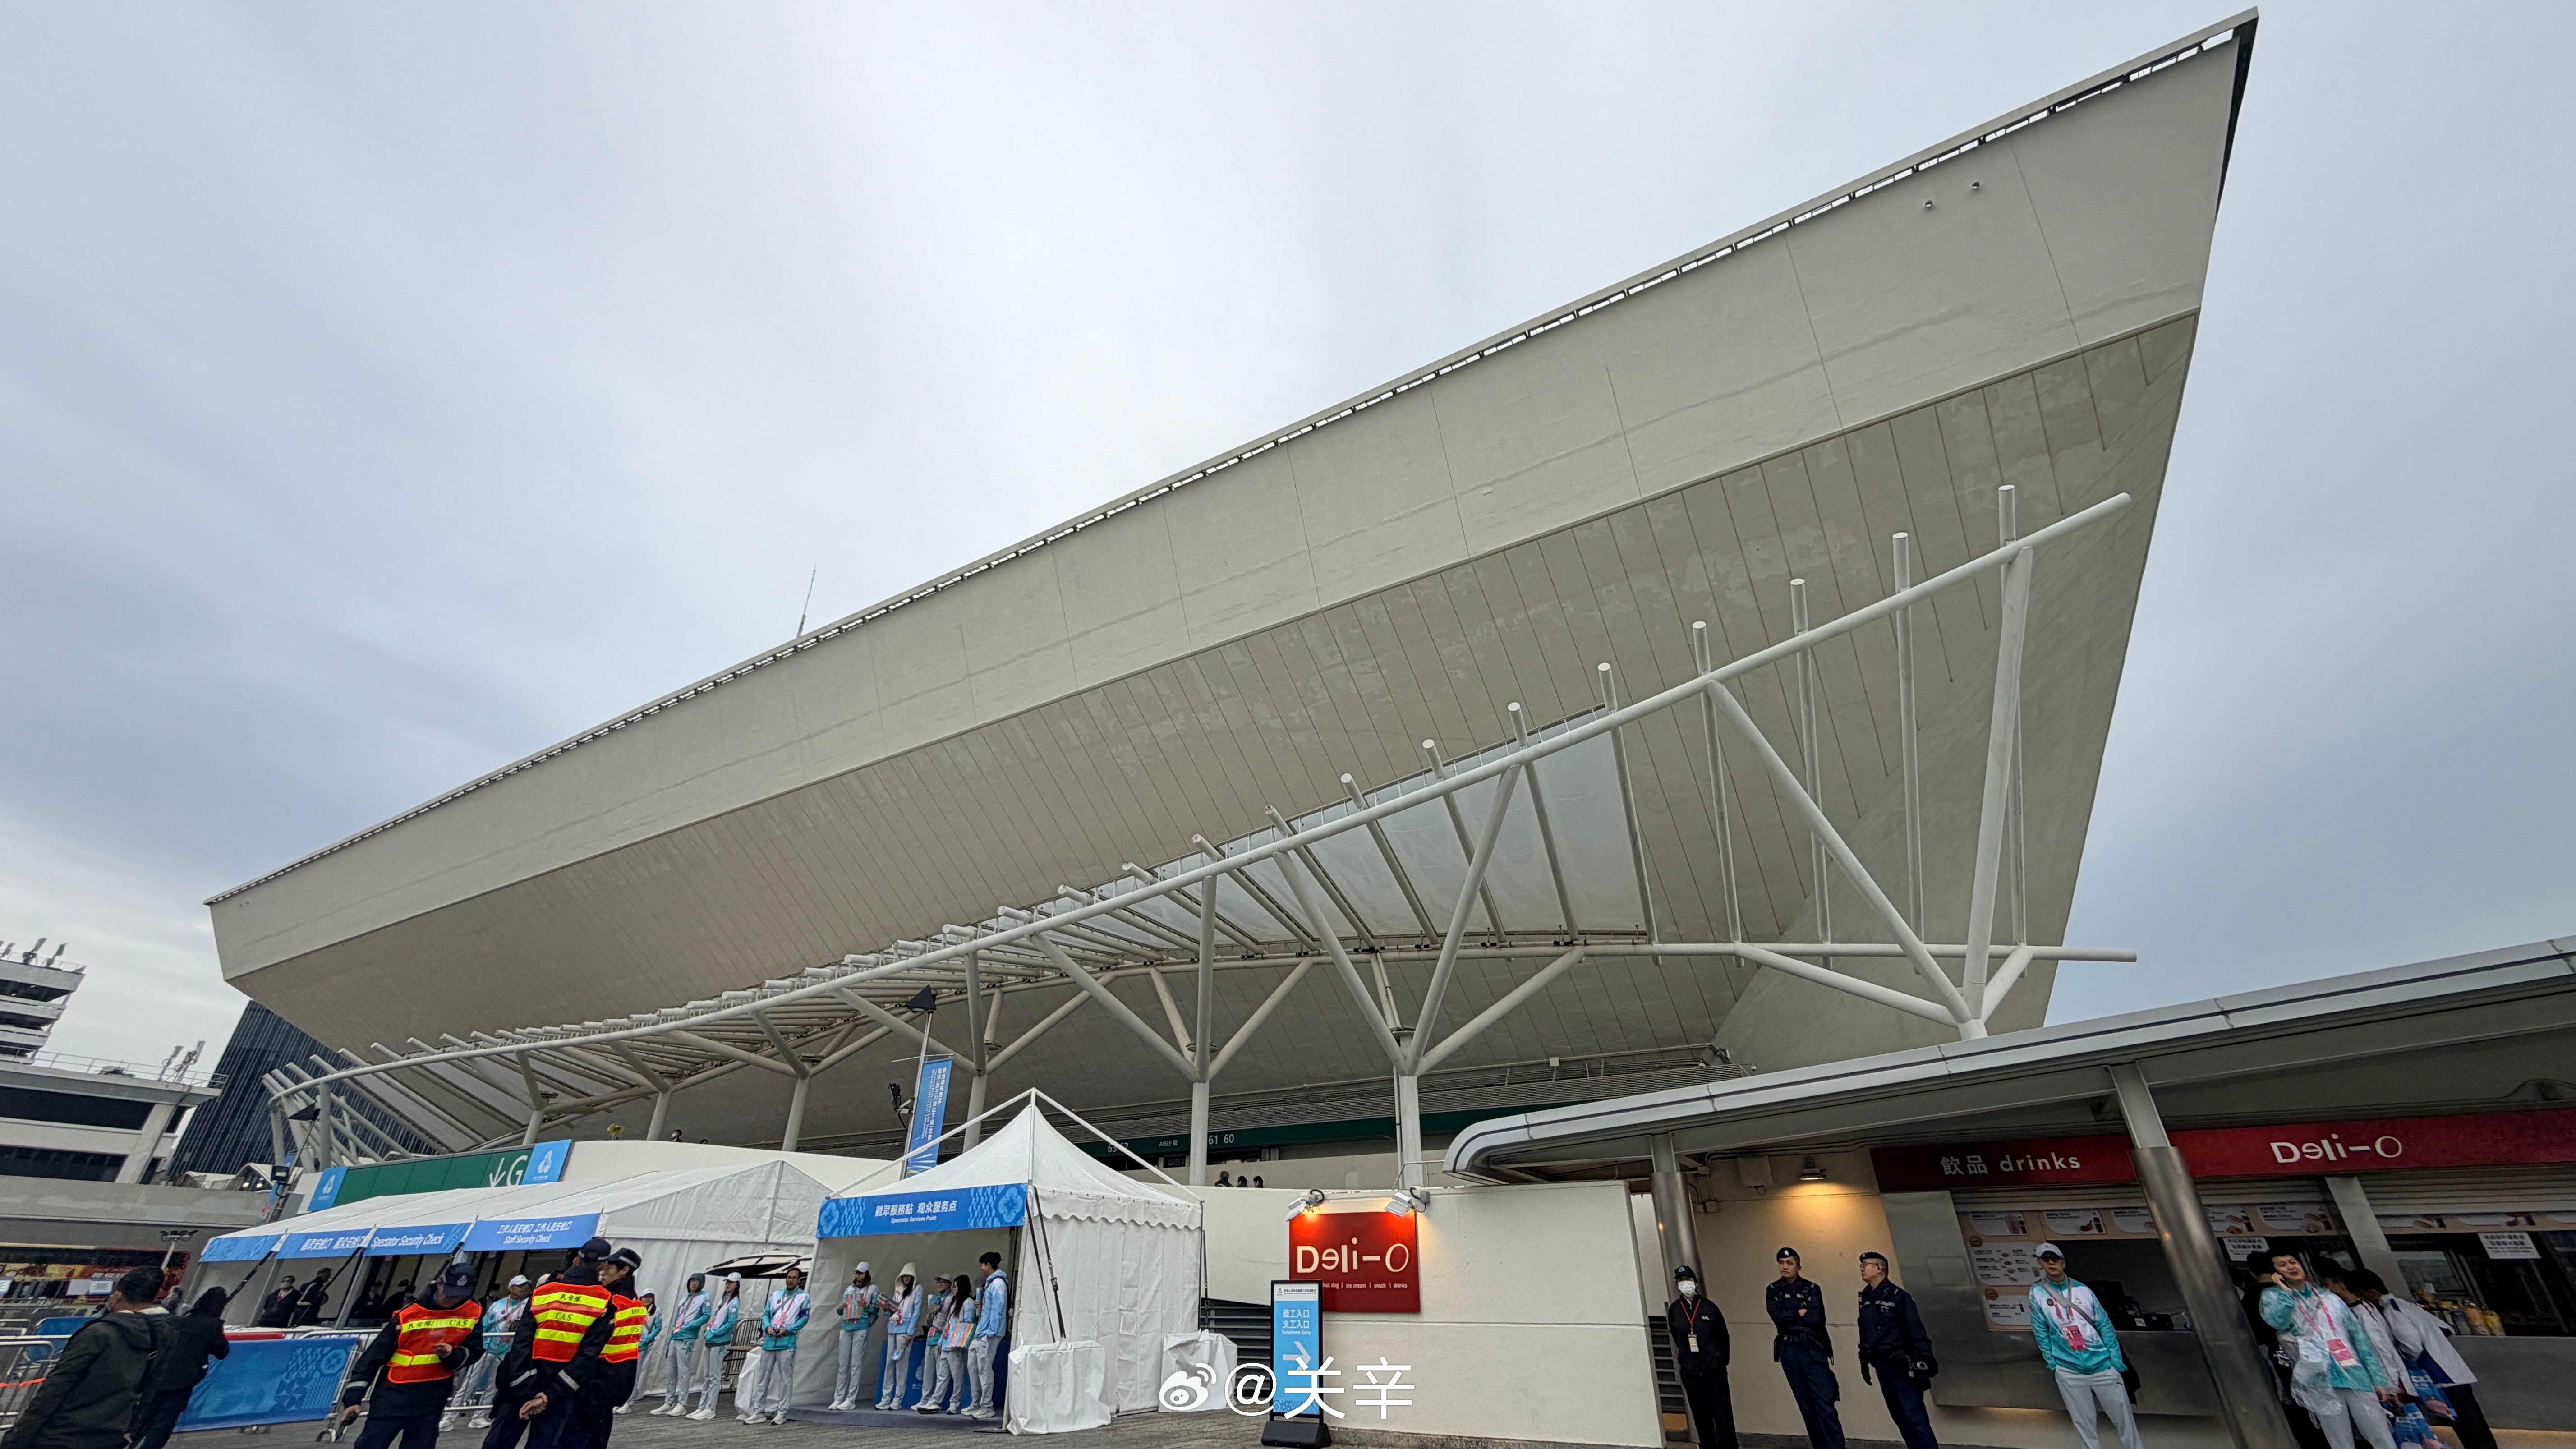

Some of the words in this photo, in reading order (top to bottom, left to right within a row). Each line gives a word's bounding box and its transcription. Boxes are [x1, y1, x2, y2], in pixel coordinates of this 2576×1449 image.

[1208, 1135, 1218, 1145] 61
[1224, 1134, 1234, 1144] 60
[2270, 1133, 2402, 1163] Deli-O
[506, 1155, 528, 1186] G
[1941, 1155, 1988, 1175] 飲品
[2000, 1152, 2080, 1172] drinks
[917, 1200, 957, 1214] 观众服务点
[371, 1236, 400, 1250] Spectator
[397, 1233, 425, 1248] Security
[423, 1232, 445, 1245] Check
[515, 1234, 536, 1245] Security
[535, 1233, 552, 1242] Check
[1297, 1237, 1409, 1273] Deli-O
[555, 1312, 573, 1321] CAS
[1283, 1320, 1310, 1329] 义工入口
